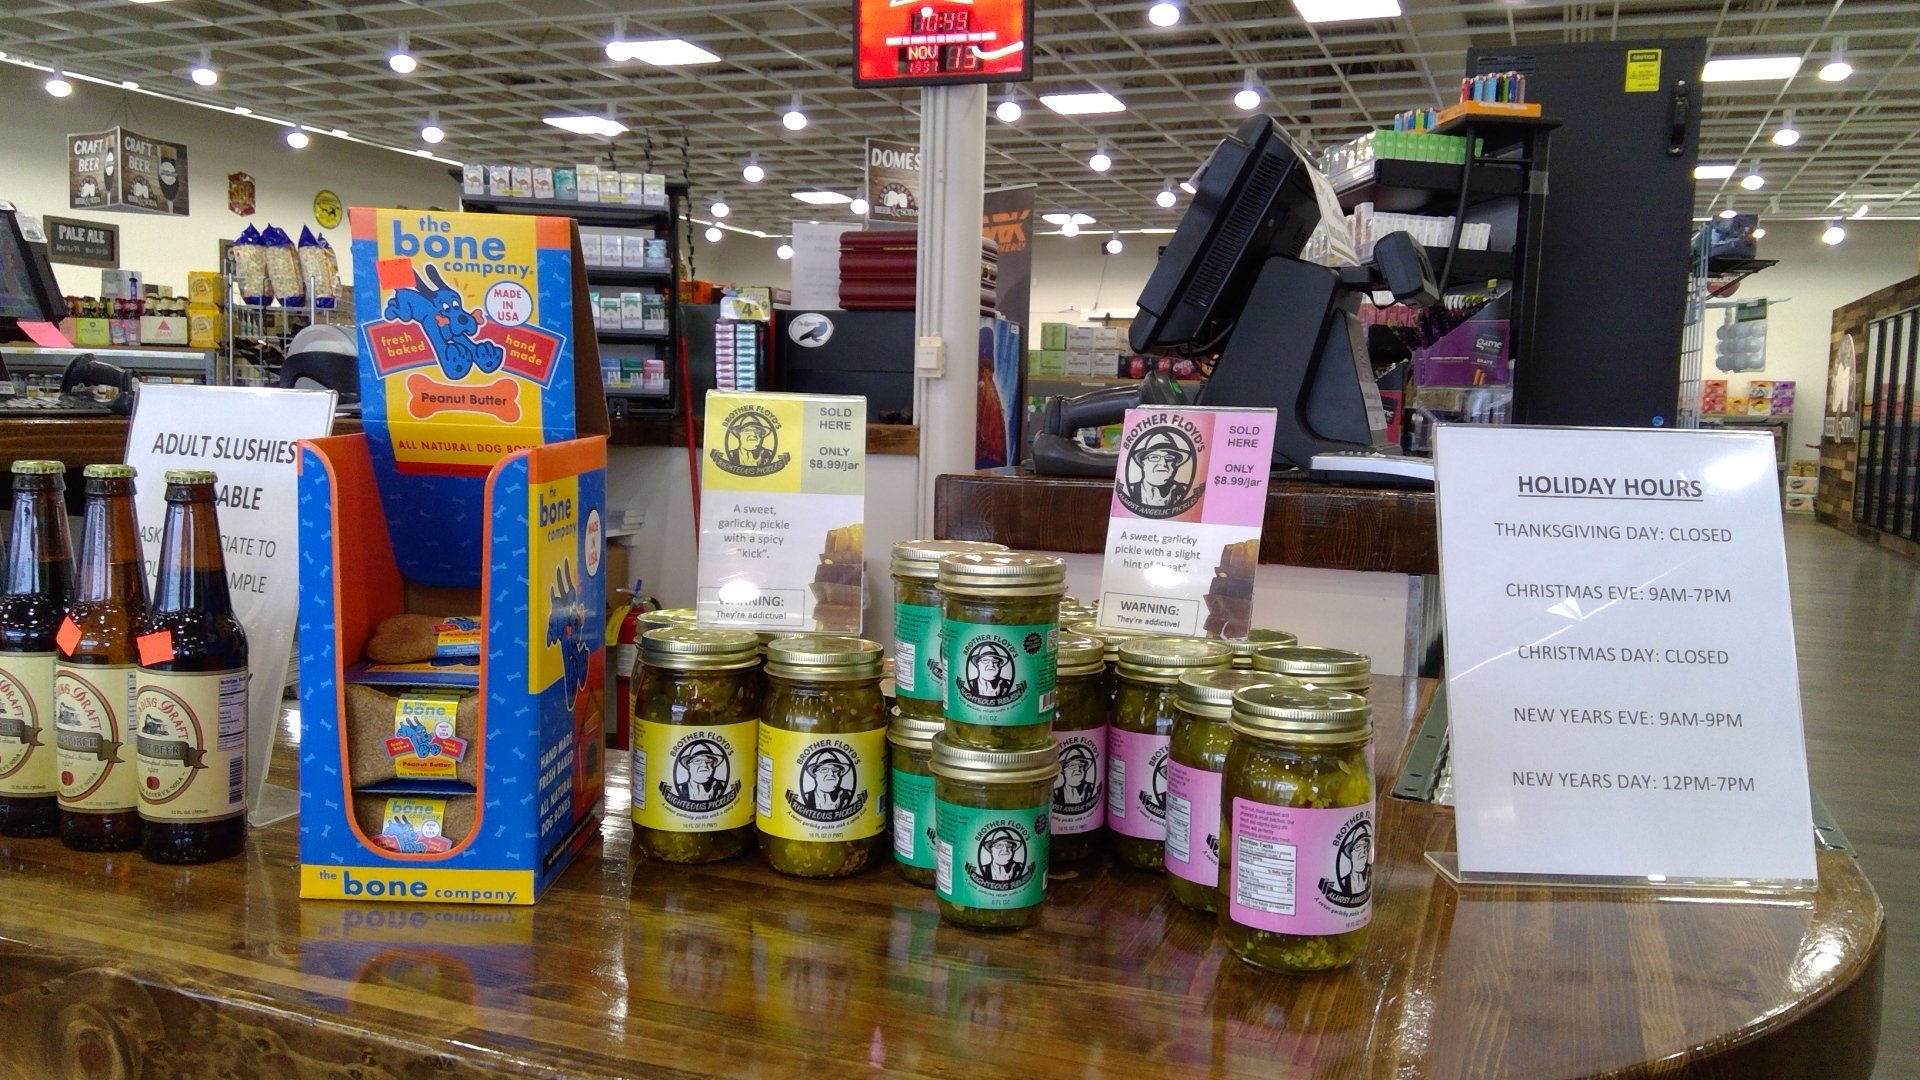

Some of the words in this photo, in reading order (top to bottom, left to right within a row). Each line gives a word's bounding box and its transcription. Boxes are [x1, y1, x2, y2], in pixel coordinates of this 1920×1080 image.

[908, 46, 938, 60] NOV
[74, 139, 104, 155] CRAFT
[124, 136, 153, 157] CRAFT
[78, 157, 100, 172] BEER
[128, 156, 151, 173] BEER
[419, 215, 451, 233] the
[58, 225, 86, 242] PALE
[87, 229, 105, 244] ALE
[392, 219, 506, 261] bone
[493, 289, 522, 300] MADE
[502, 300, 514, 311] IN
[497, 311, 520, 322] USA
[381, 332, 413, 347] fresh
[504, 334, 536, 353] hand
[1475, 338, 1503, 351] game
[387, 341, 426, 358] baked
[509, 348, 543, 367] made
[421, 392, 466, 405] Peanut
[469, 394, 508, 407] Butter
[722, 405, 754, 427] BROTHER
[756, 405, 782, 430] FLOYD'S
[819, 407, 852, 418] SOLD
[819, 420, 852, 431] HERE
[1123, 412, 1168, 451] BROTHER
[1171, 413, 1206, 454] FLOYD'S
[1229, 425, 1260, 436] SOLD
[152, 433, 212, 458] ADULT
[212, 436, 297, 465] SLUSHIES
[398, 440, 417, 450] ALL
[421, 440, 473, 453] NATURAL
[477, 442, 502, 454] DOG
[819, 446, 850, 457] ONLY
[1227, 438, 1259, 449] HERE
[716, 460, 754, 475] RIGHTEOUS
[755, 461, 784, 475] PICKLES
[809, 459, 860, 471] $8.99/jar
[1224, 464, 1254, 474] ONLY
[1214, 476, 1262, 488] $8.99/jar
[1518, 475, 1617, 496] HOLIDAY
[1624, 478, 1703, 498] HOURS
[216, 484, 264, 511] ABLE
[1118, 492, 1140, 511] ALMOST
[1139, 507, 1171, 516] ANGELIC
[1171, 496, 1198, 514] PICKLES
[539, 493, 572, 528] bone
[733, 504, 741, 514] A
[742, 505, 777, 516] sweet,
[718, 517, 757, 531] garlicky
[759, 518, 790, 530] pickle
[1494, 523, 1621, 540] THANKSGIVING
[1626, 525, 1664, 541] DAY:
[1669, 527, 1732, 543] CLOSED
[140, 526, 162, 544] ASK
[258, 539, 277, 558] TO
[723, 532, 746, 544] with
[749, 536, 755, 544] a
[758, 534, 784, 546] spicy
[1120, 531, 1128, 540] A
[1129, 533, 1160, 544] sweet,
[1161, 535, 1198, 547] garlicky
[1115, 545, 1142, 555] pickle
[1144, 547, 1165, 557] with
[1166, 549, 1172, 557] a
[1174, 550, 1201, 561] slight
[1123, 558, 1142, 569] hint
[1143, 560, 1155, 570] of
[229, 572, 268, 594] MPLE
[1505, 583, 1603, 600] CHRISTMAS
[1608, 585, 1645, 602] EVE:
[1648, 587, 1732, 603] 9AM-7PM
[716, 610, 746, 620] They're
[748, 611, 787, 620] addictive!
[1120, 599, 1180, 617] WARNING:
[1117, 614, 1143, 626] They're
[1144, 617, 1180, 628] addictive!
[962, 634, 992, 656] BROTHER
[993, 634, 1020, 659] FLOYD'S
[1517, 645, 1616, 662] CHRISTMAS
[1621, 647, 1660, 663] DAY:
[1664, 649, 1729, 665] CLOSED
[960, 687, 996, 706] RIGHTEOUS
[71, 687, 102, 731] DRAFT
[402, 701, 447, 716] bone
[1514, 707, 1554, 724] NEW
[1559, 708, 1613, 725] YEARS
[1618, 710, 1654, 726] EVE:
[1659, 711, 1743, 728] 9AM-9PM
[158, 700, 189, 740] DRAFT
[154, 744, 179, 755] BEER
[670, 731, 705, 757] BROTHER
[707, 731, 734, 757] FLOYD'S
[796, 739, 832, 766] BROTHER
[833, 739, 862, 766] FLOYD'S
[1059, 737, 1079, 750] THER
[540, 744, 558, 770] HAND
[539, 765, 557, 793] FRESH
[1512, 771, 1553, 787] NEW
[1558, 772, 1612, 789] YEARS
[1617, 774, 1657, 790] DAY:
[1662, 775, 1755, 792] 12PM-7PM
[391, 800, 434, 814] bone
[666, 792, 707, 811] RIGHTEOUS
[707, 791, 735, 810] PICKLES
[792, 801, 833, 821] RIGHTEOUS
[833, 802, 863, 821] PICKLES
[974, 819, 1006, 842] BROTHER
[1332, 811, 1365, 847] BROTHER
[319, 870, 337, 881] the
[343, 871, 428, 898] bone
[970, 872, 1009, 890] RIGHTEOUS
[1327, 891, 1351, 905] ALMOST
